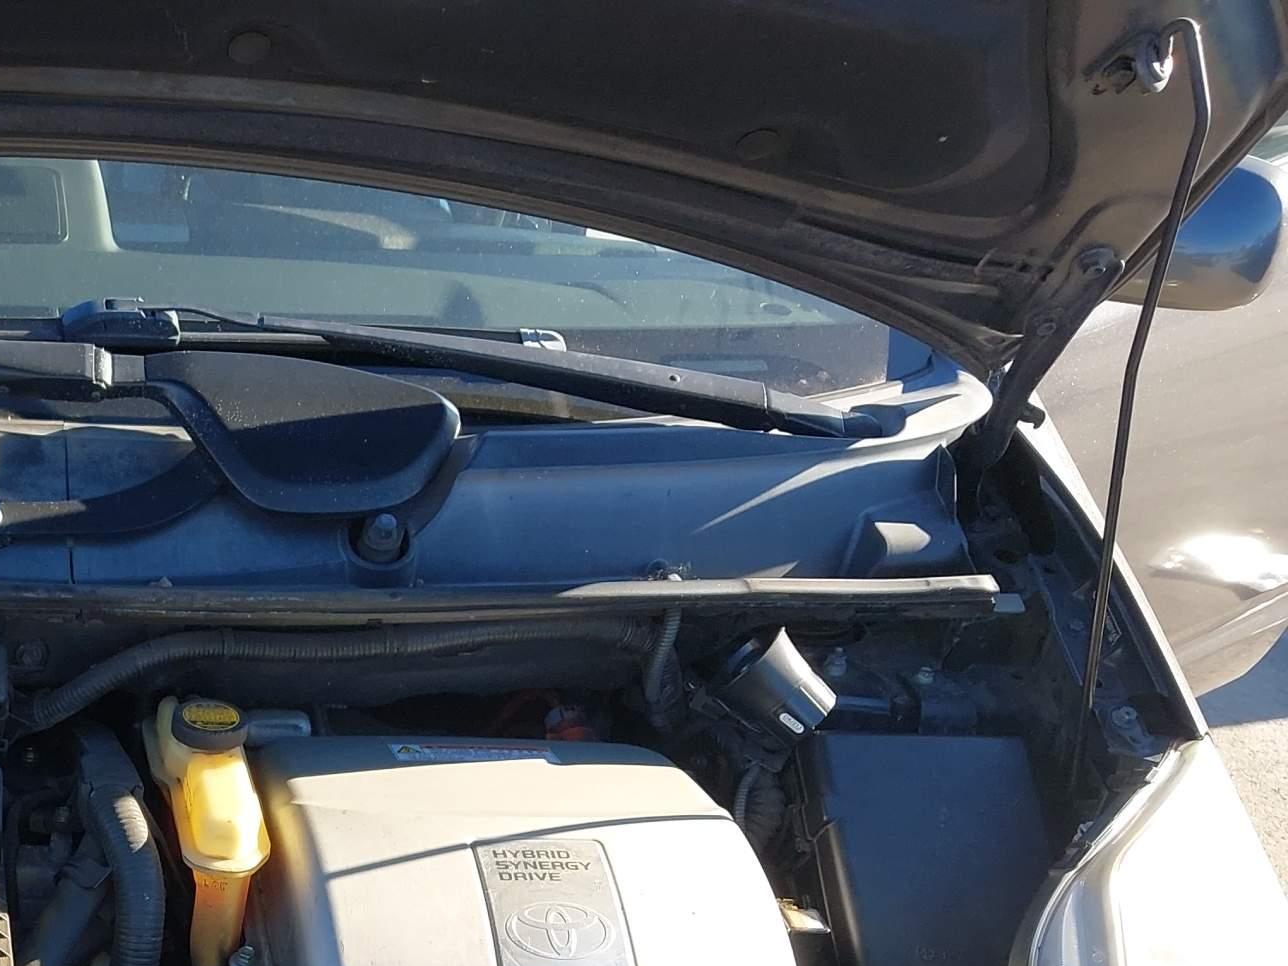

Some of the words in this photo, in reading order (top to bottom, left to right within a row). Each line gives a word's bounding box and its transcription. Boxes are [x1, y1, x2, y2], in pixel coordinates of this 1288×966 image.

[492, 849, 570, 859] HYBRID
[495, 860, 591, 871] SYNERGY
[498, 872, 562, 881] DRIVE
